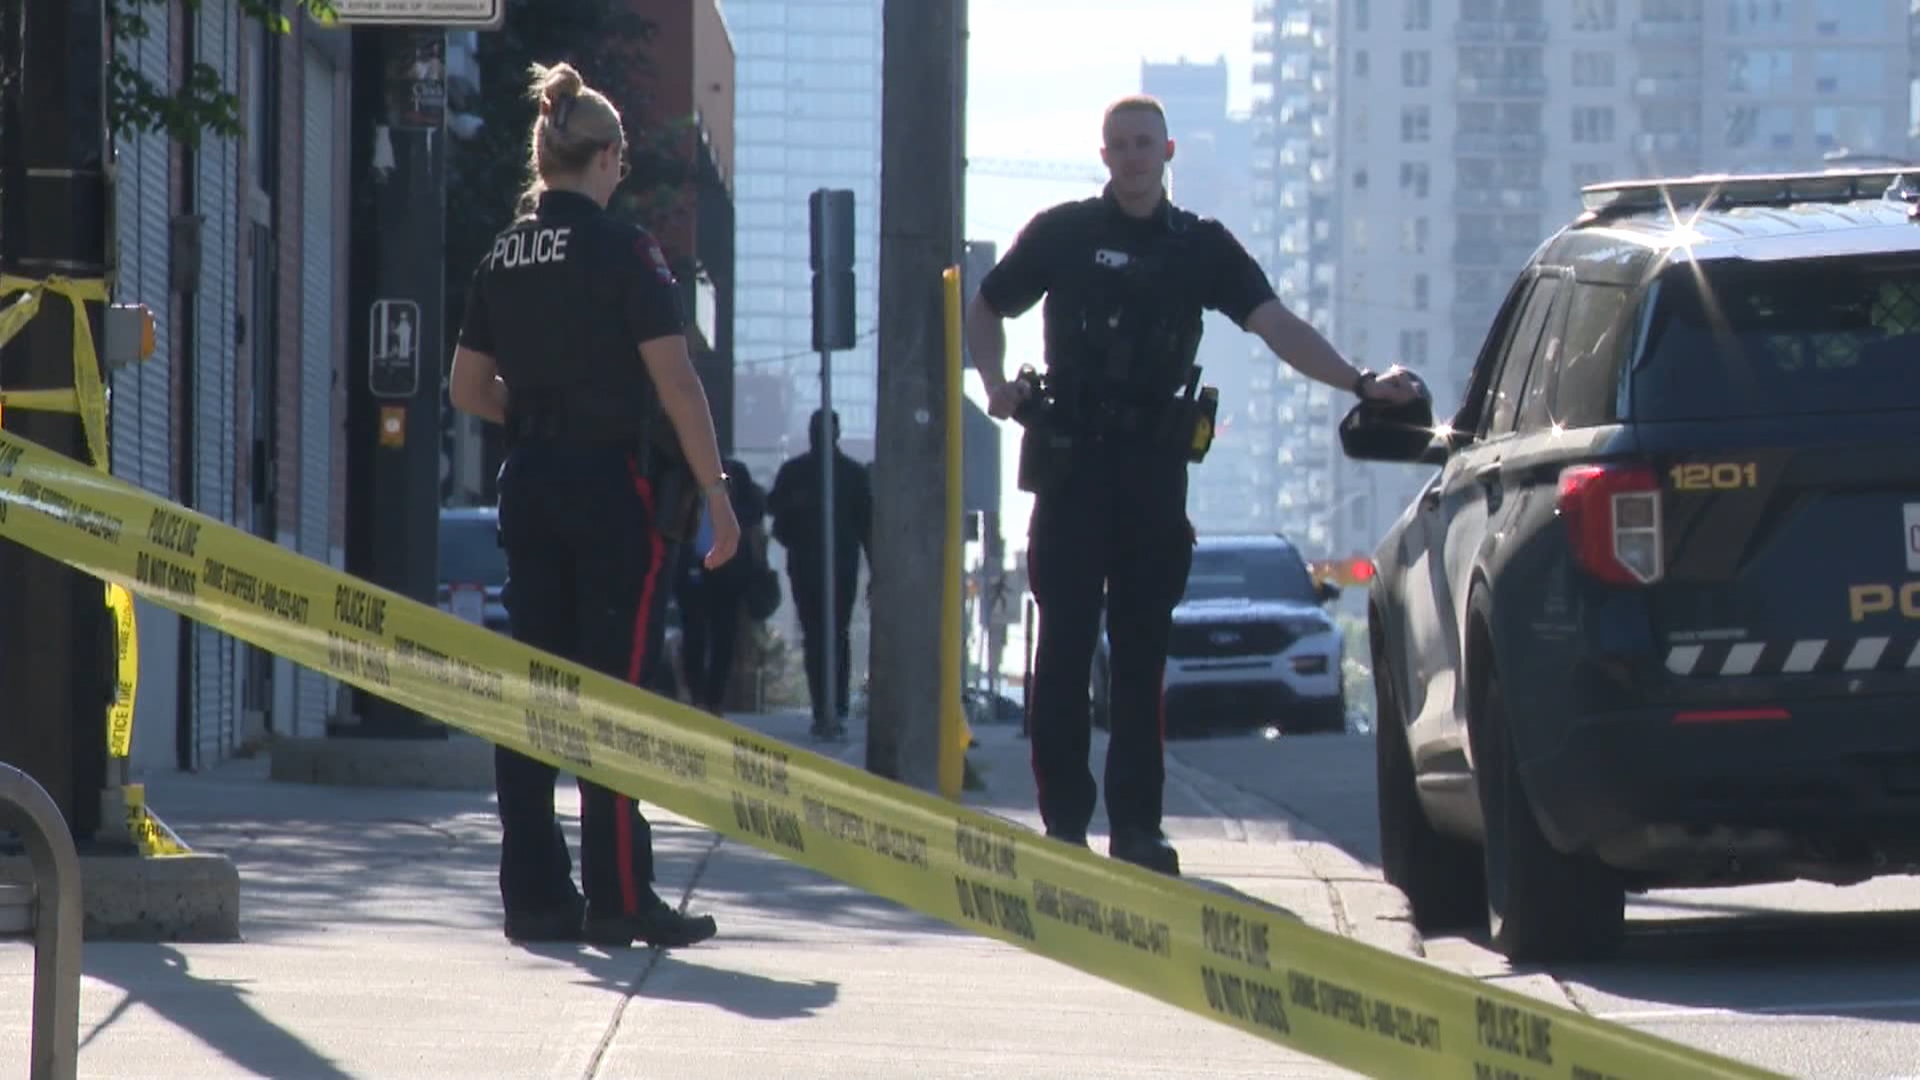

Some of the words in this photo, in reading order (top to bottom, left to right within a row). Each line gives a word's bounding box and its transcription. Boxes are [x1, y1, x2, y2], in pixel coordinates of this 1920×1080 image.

[490, 227, 572, 271] POLICE
[1669, 462, 1757, 489] 1201
[148, 507, 181, 549] POLICE
[177, 518, 201, 558] LINE
[136, 551, 149, 585] DO
[150, 556, 168, 590] NOT
[168, 563, 196, 597] CROSS
[203, 557, 225, 590] CRIME
[224, 565, 258, 604] STOPPERS
[334, 583, 366, 628] POLICE
[365, 595, 386, 636] LINE
[733, 736, 767, 788] POLICE
[766, 750, 789, 795] LINE
[732, 790, 750, 832] DO
[747, 797, 770, 840] NOT
[767, 804, 805, 852] CROSS
[802, 793, 829, 831] CRIME
[827, 804, 868, 847] STOPPERS
[956, 817, 993, 871] POLICE
[991, 828, 1017, 880] LINE
[954, 874, 976, 921] DO
[970, 879, 998, 928] NOT
[993, 888, 1036, 942] CROSS
[1033, 879, 1061, 920] CRIME
[1060, 888, 1104, 935] STOPPERS
[1202, 904, 1243, 961] POLICE
[1243, 918, 1271, 972] LINE
[1201, 965, 1225, 1013] DO
[1219, 971, 1249, 1020] NOT
[1245, 978, 1290, 1035] CROSS
[1288, 968, 1319, 1012] CRIME
[1318, 979, 1367, 1030] STOPPERS
[1476, 997, 1522, 1058] POLICE
[1522, 1011, 1553, 1066] LINE
